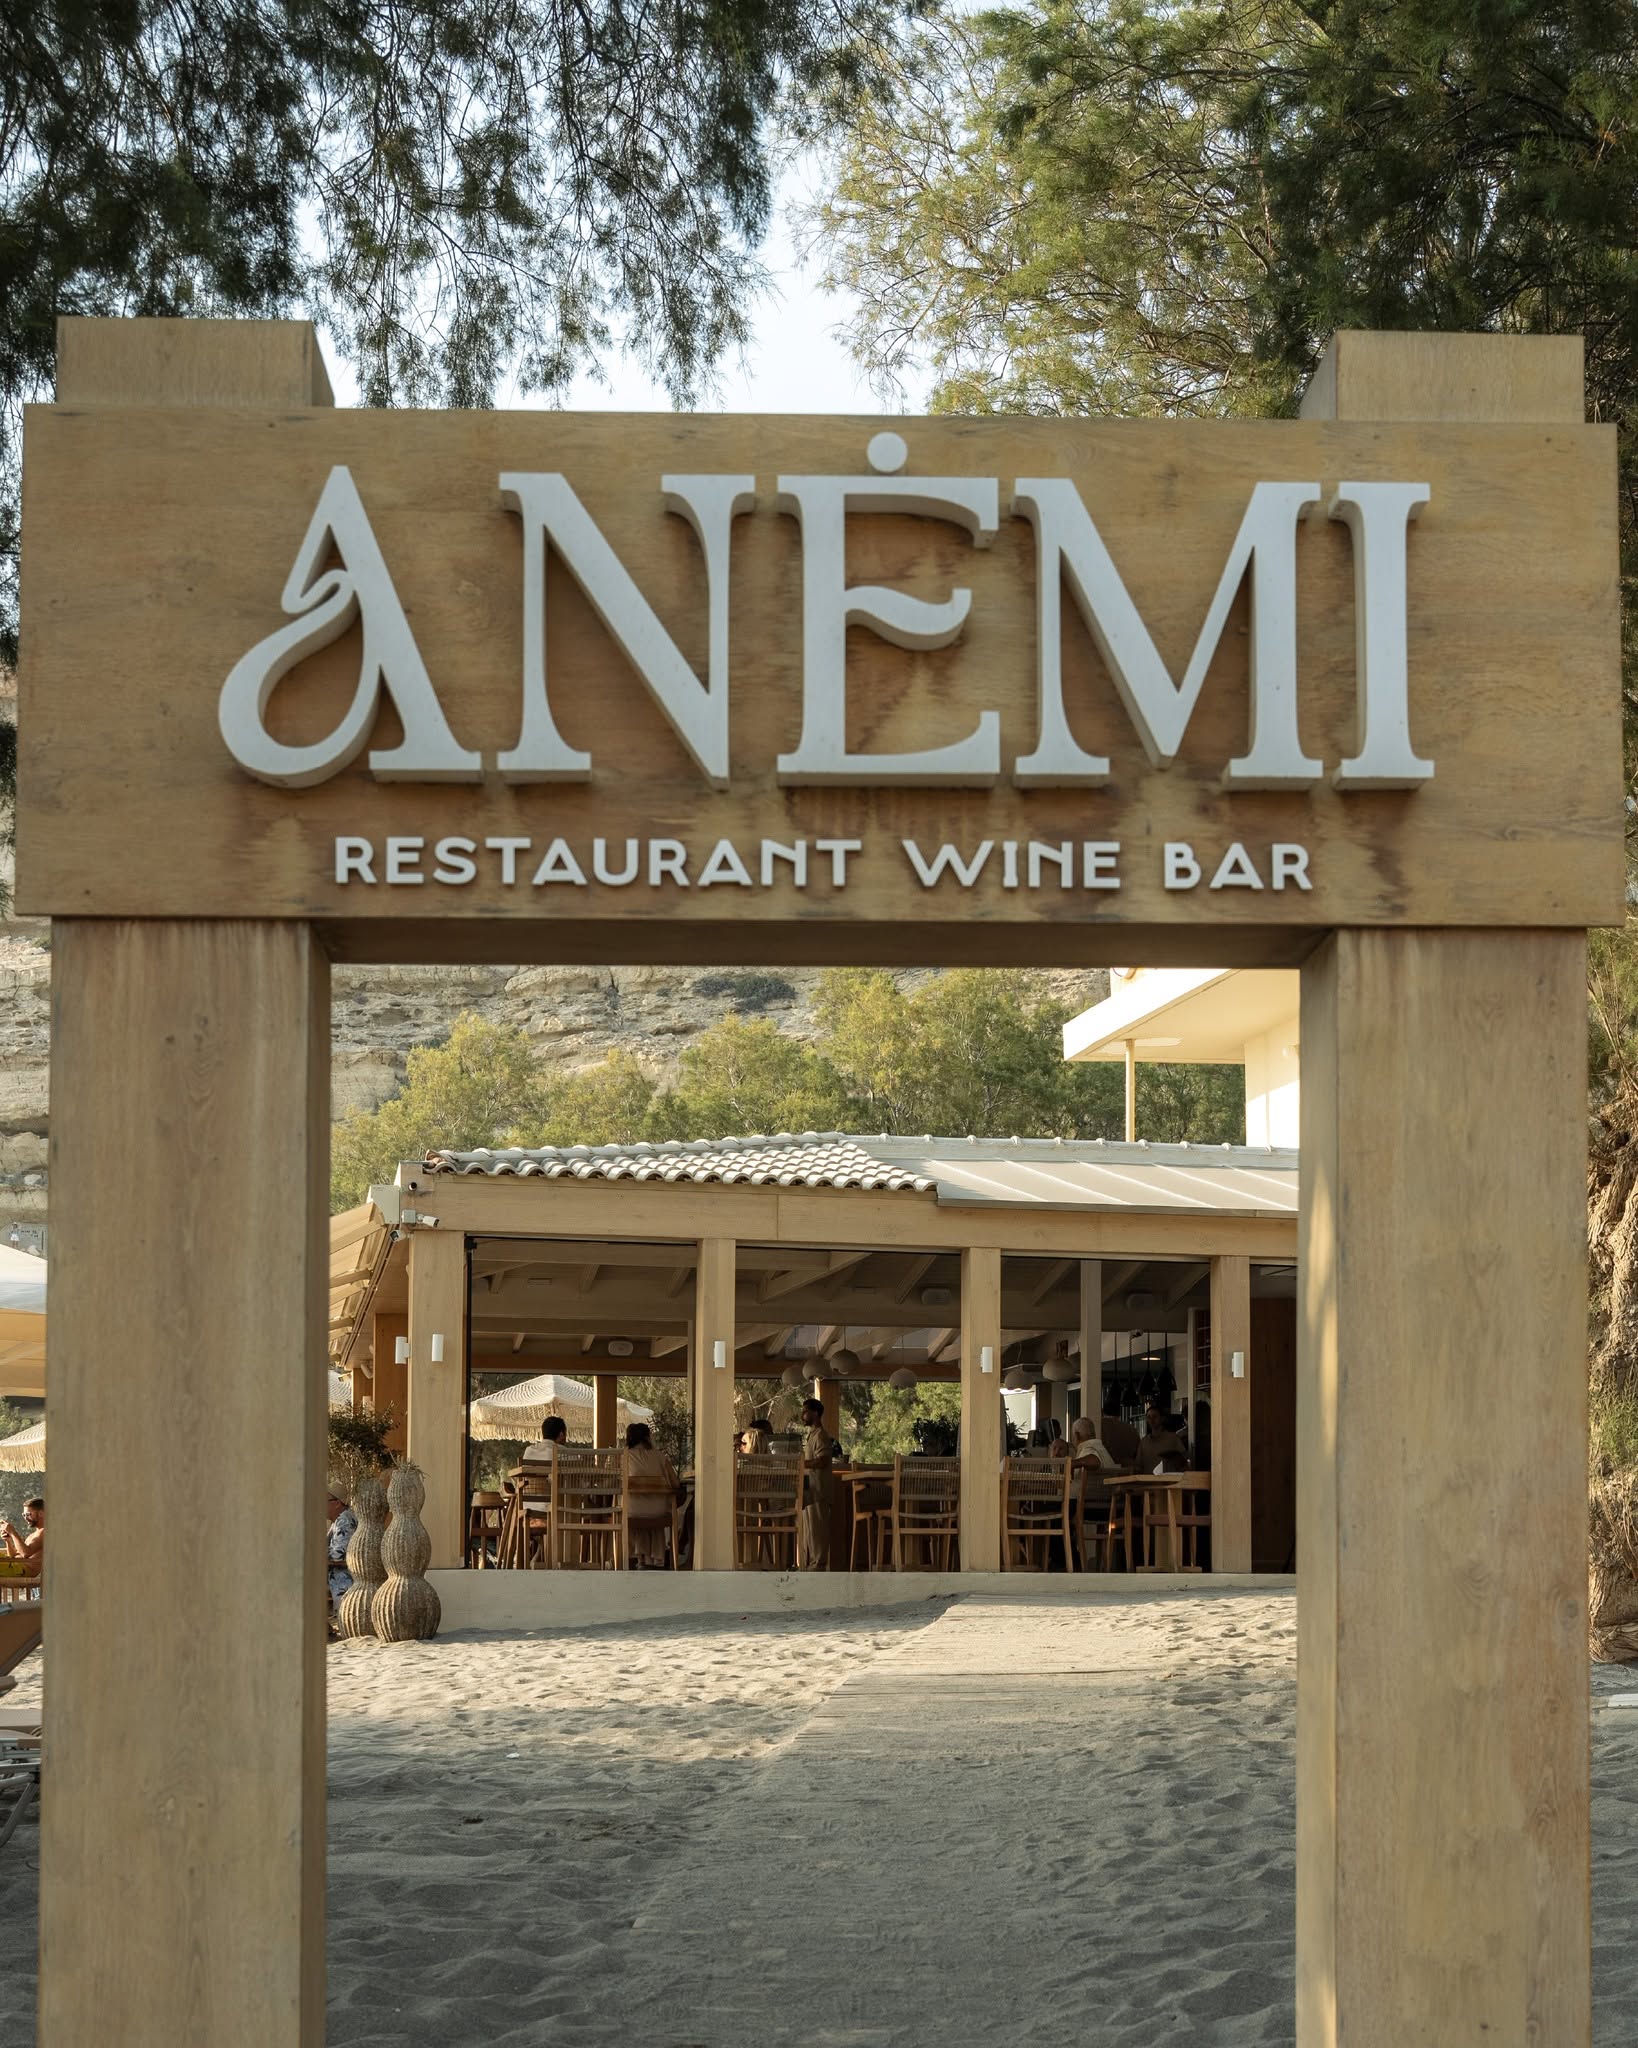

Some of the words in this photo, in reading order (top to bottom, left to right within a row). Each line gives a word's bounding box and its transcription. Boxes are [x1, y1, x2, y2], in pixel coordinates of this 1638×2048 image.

[335, 836, 862, 886] RESTAURANT
[902, 839, 1121, 888] WINE
[1164, 842, 1313, 890] BAR
